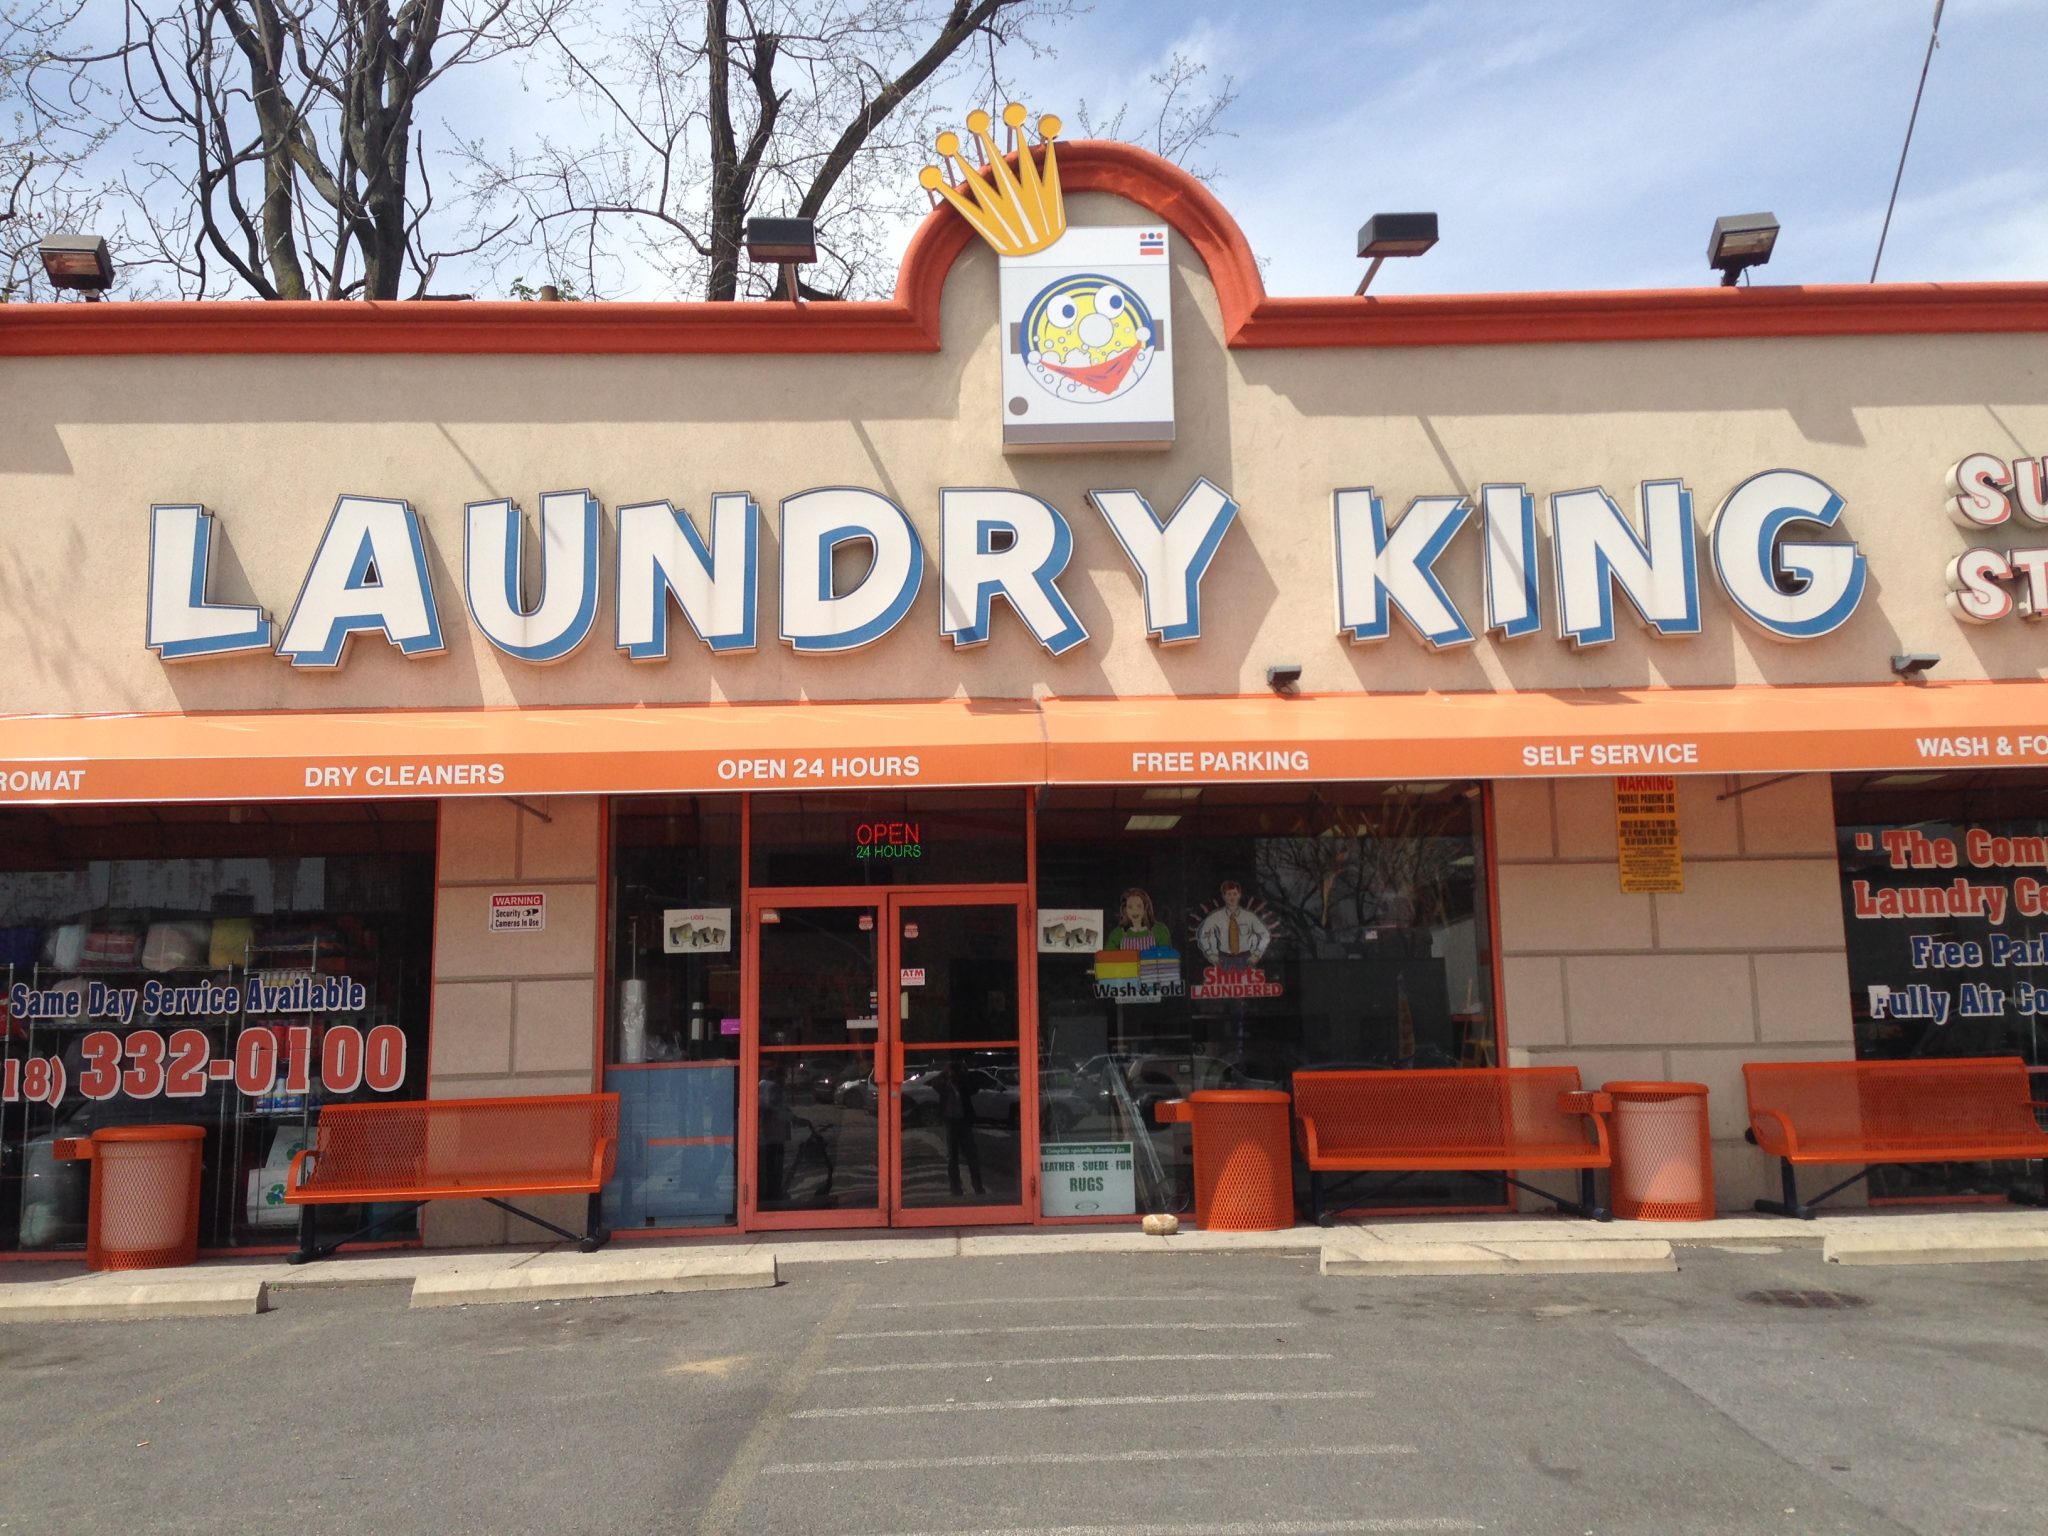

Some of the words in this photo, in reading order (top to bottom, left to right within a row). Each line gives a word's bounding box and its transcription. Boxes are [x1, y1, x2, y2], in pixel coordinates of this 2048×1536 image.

[145, 475, 1240, 667] LAUNDRY
[1333, 468, 1868, 649] KING
[1522, 745, 1584, 766] SELF
[1590, 743, 1699, 765] SERVICE
[1916, 736, 1990, 757] WASH
[1996, 735, 2013, 756] &
[2018, 735, 2048, 755] FO
[717, 759, 786, 780] OPEN
[793, 757, 825, 779] 24
[831, 756, 920, 777] HOURS
[1132, 751, 1194, 772] FREE
[1200, 750, 1310, 772] PARKING
[304, 766, 358, 787] DRY
[365, 763, 505, 786] CLEANERS
[1616, 775, 1674, 791] WARNING
[856, 823, 920, 845] OPEN
[856, 845, 871, 859] 24
[874, 845, 922, 859] HOURS
[1882, 830, 1958, 869] The
[1966, 828, 2048, 870] Com
[495, 896, 541, 905] WARNING
[1853, 877, 2008, 925] Laundry
[495, 909, 521, 918] Security
[495, 919, 520, 928] Cameras
[522, 919, 527, 927] In
[529, 918, 539, 926] Use
[1910, 936, 1984, 968] Free
[1203, 964, 1266, 985] Shirts
[11, 983, 81, 1018] Same
[88, 981, 138, 1023] Day
[143, 979, 240, 1016] Service
[245, 975, 366, 1013] Available
[1093, 982, 1136, 997] Wash
[1138, 981, 1150, 997] &
[1152, 980, 1185, 997] Fold
[1190, 983, 1284, 1000] LAUNDERED
[1867, 984, 1951, 1026] Fully
[1959, 982, 2005, 1017] Air
[80, 1025, 407, 1100] 332-0100
[1040, 1161, 1075, 1172] LEATHER
[1082, 1161, 1109, 1171] SUEDE
[1116, 1160, 1132, 1170] FUR
[1069, 1177, 1104, 1192] RUGS
